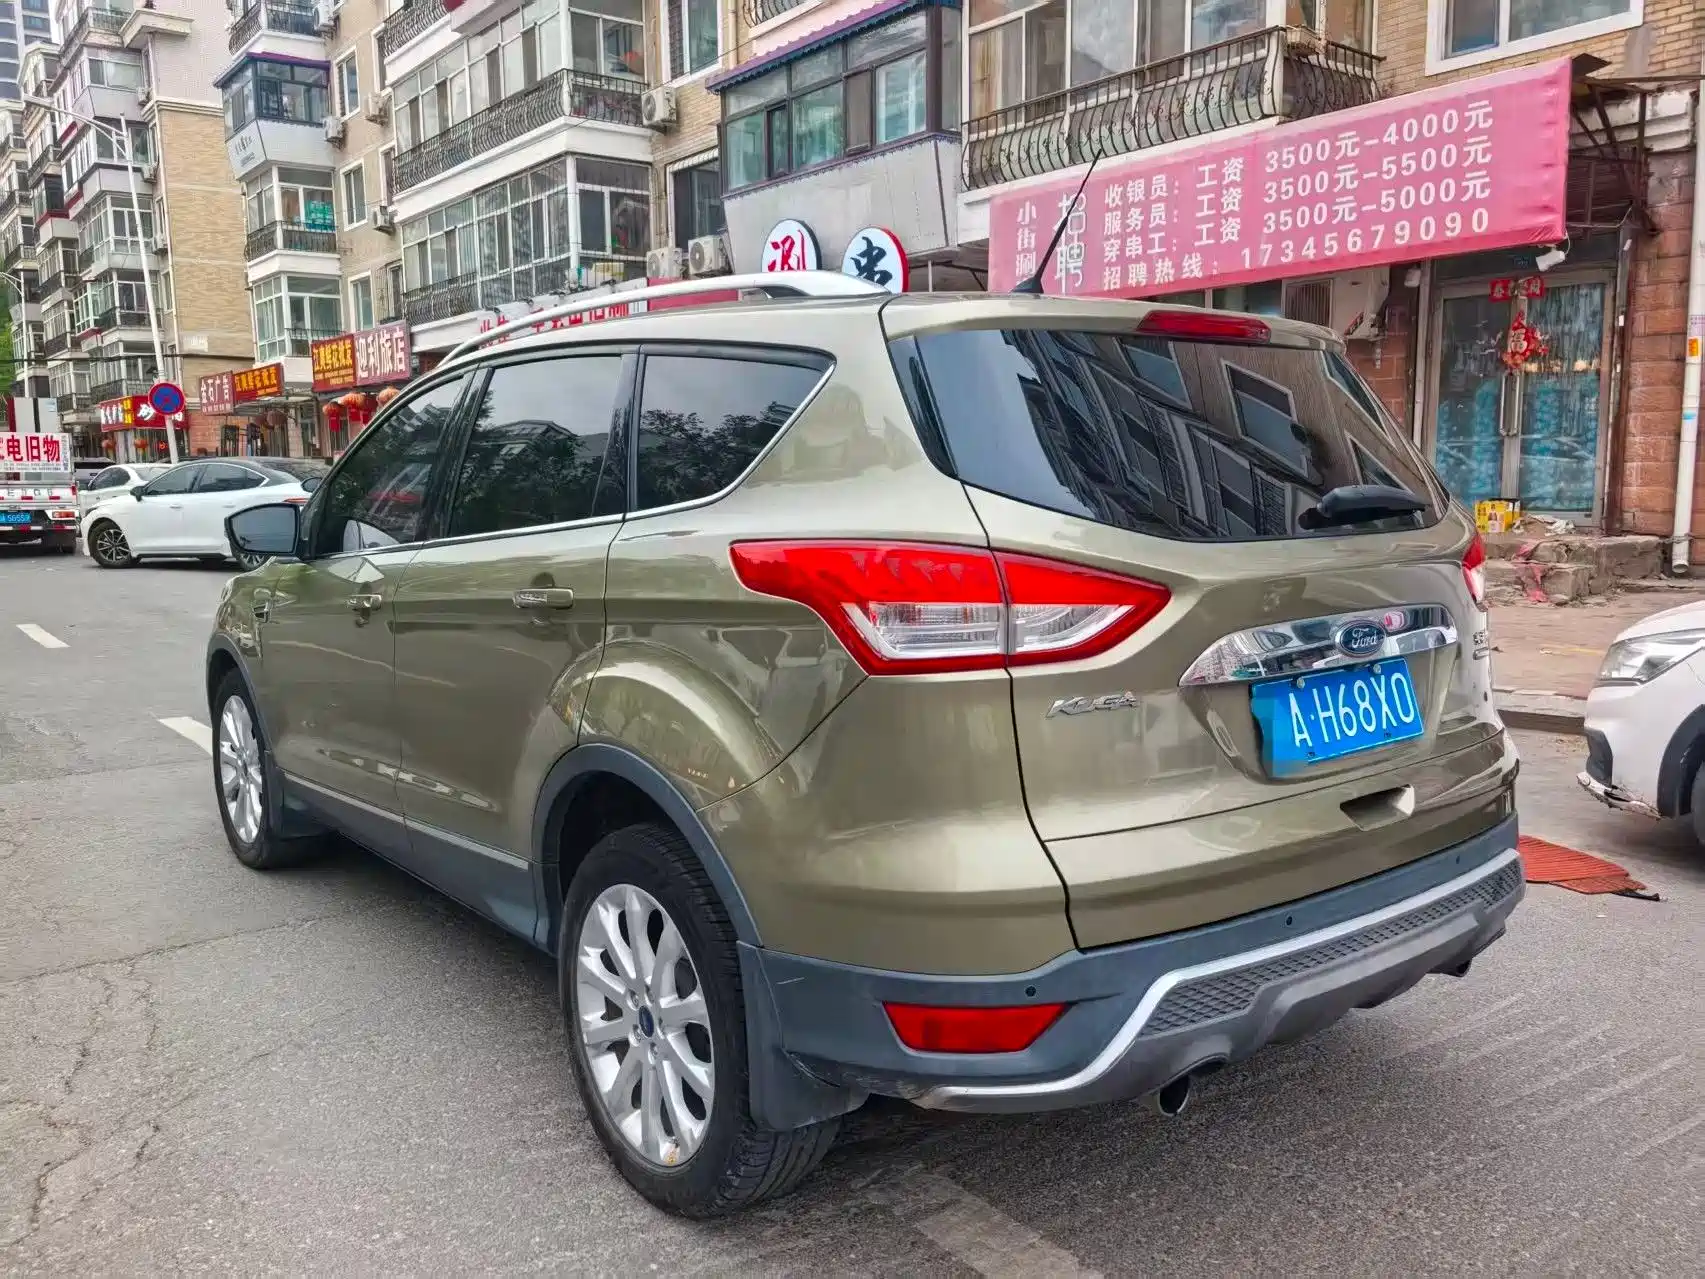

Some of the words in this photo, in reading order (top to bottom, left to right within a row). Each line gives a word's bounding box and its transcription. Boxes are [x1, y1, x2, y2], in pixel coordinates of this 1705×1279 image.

[1196, 157, 1244, 188] 工资
[1265, 100, 1493, 173] 3500元-4000元
[1196, 187, 1243, 217] 工资
[1264, 135, 1492, 203] 3500元-5500元
[1053, 192, 1087, 296] 招聘
[1194, 217, 1241, 247] 工资
[1263, 170, 1491, 234] 3500元-5000元
[1241, 208, 1489, 269] 17345679090
[0, 435, 60, 462] 电旧物
[1351, 628, 1379, 648] Ford
